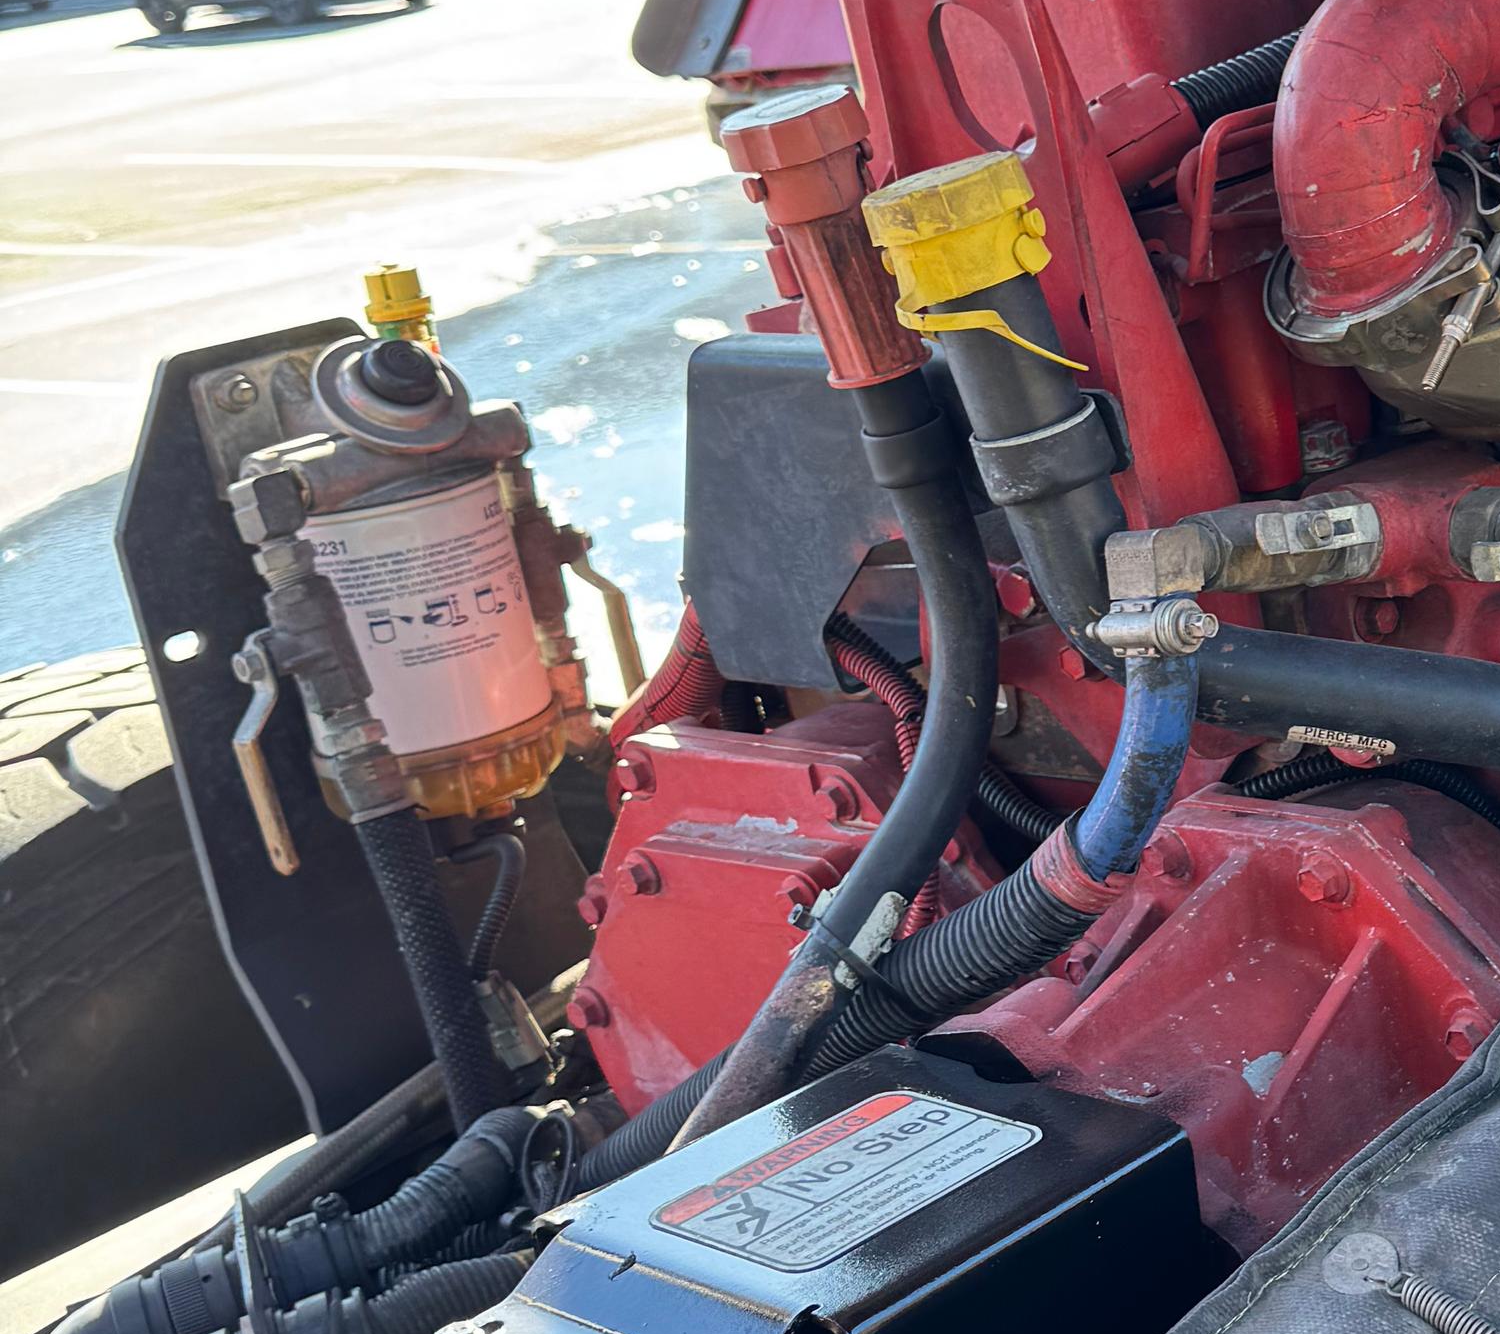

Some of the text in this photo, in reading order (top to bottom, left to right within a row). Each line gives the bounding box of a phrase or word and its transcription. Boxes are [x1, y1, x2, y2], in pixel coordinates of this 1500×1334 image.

[1304, 727, 1353, 743] PIERCE
[1357, 736, 1388, 749] MFG
[740, 1115, 867, 1182] WARNING
[781, 1109, 951, 1192] No Step
[759, 1173, 897, 1246] Railings NOT provided.
[776, 1224, 826, 1251] Surface
[826, 1209, 853, 1224] may
[870, 1174, 918, 1199] slippery
[923, 1154, 950, 1170] NOT
